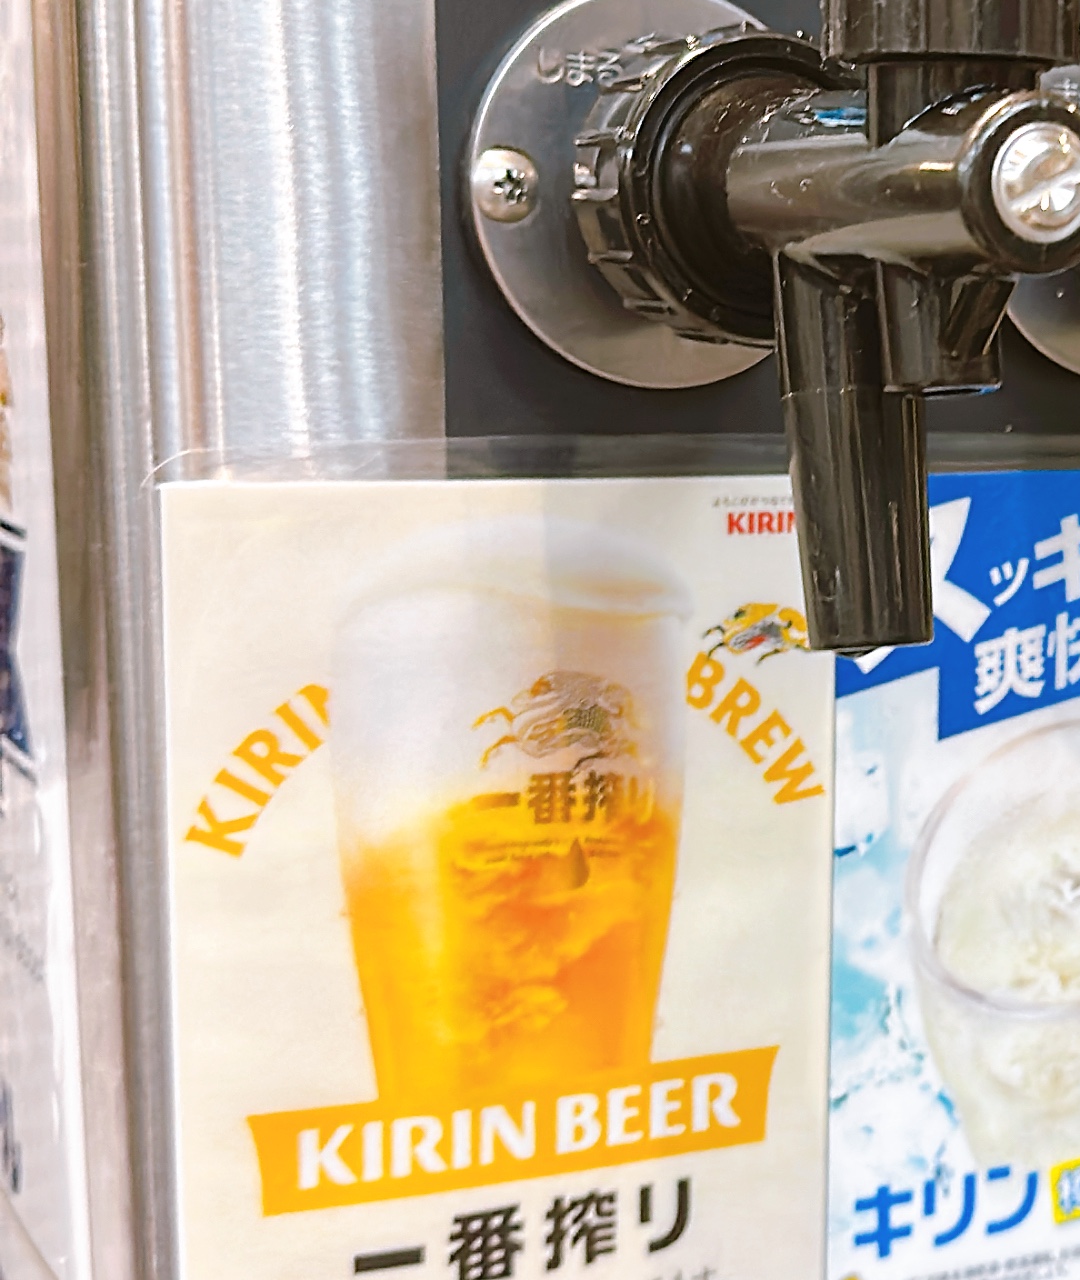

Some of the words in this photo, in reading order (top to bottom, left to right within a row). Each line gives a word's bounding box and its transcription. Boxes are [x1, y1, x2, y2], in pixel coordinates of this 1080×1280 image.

[685, 652, 825, 805] BREW
[298, 1100, 535, 1190] KIRIN
[555, 1073, 741, 1155] BEER
[855, 1167, 1038, 1259] キリン
